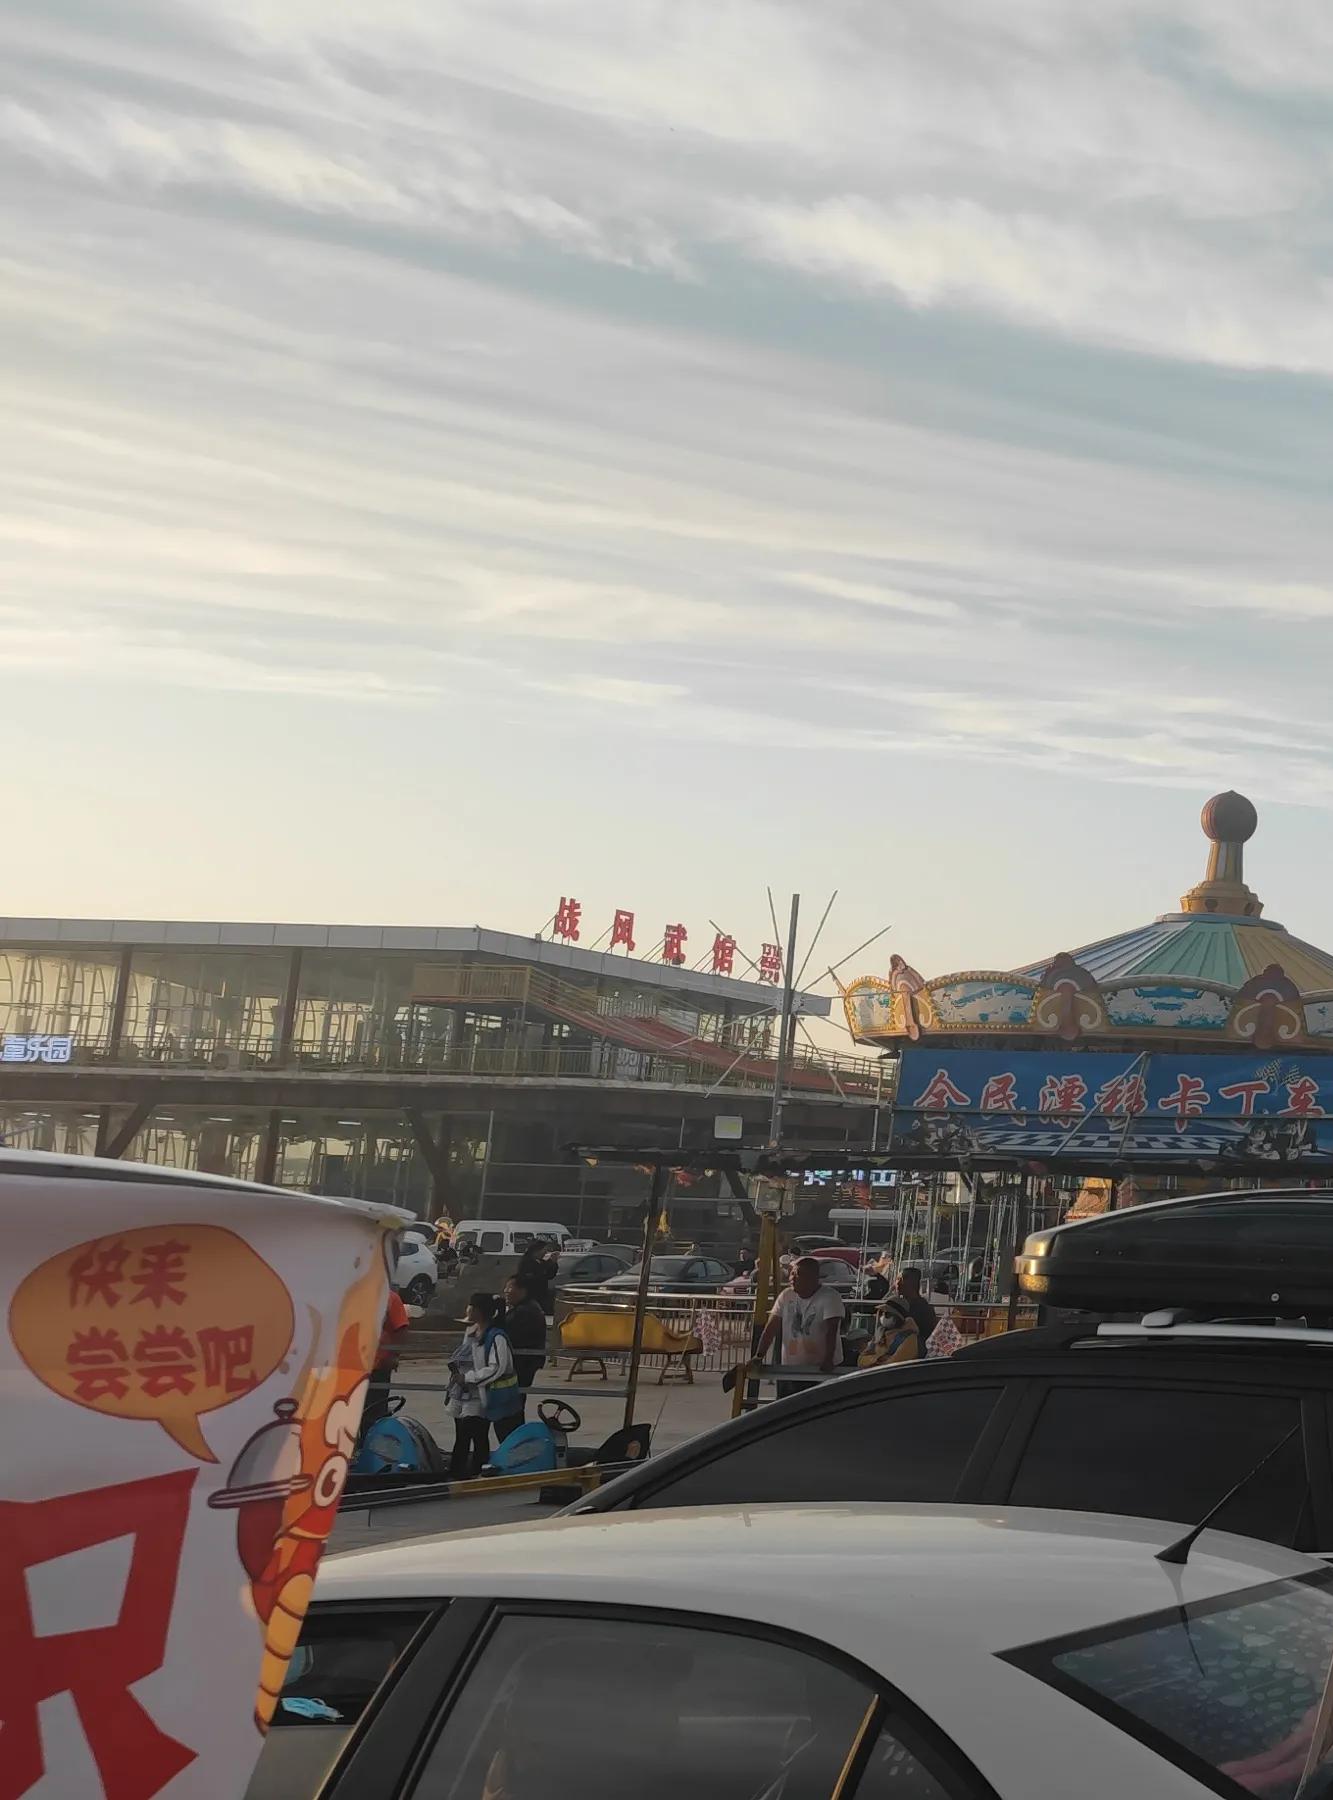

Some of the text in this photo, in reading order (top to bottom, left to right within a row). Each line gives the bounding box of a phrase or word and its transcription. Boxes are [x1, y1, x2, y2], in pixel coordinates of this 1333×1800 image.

[0, 1033, 73, 1063] 童乐园
[65, 1237, 192, 1310] 快来
[65, 1324, 260, 1403] 尝尝吧
